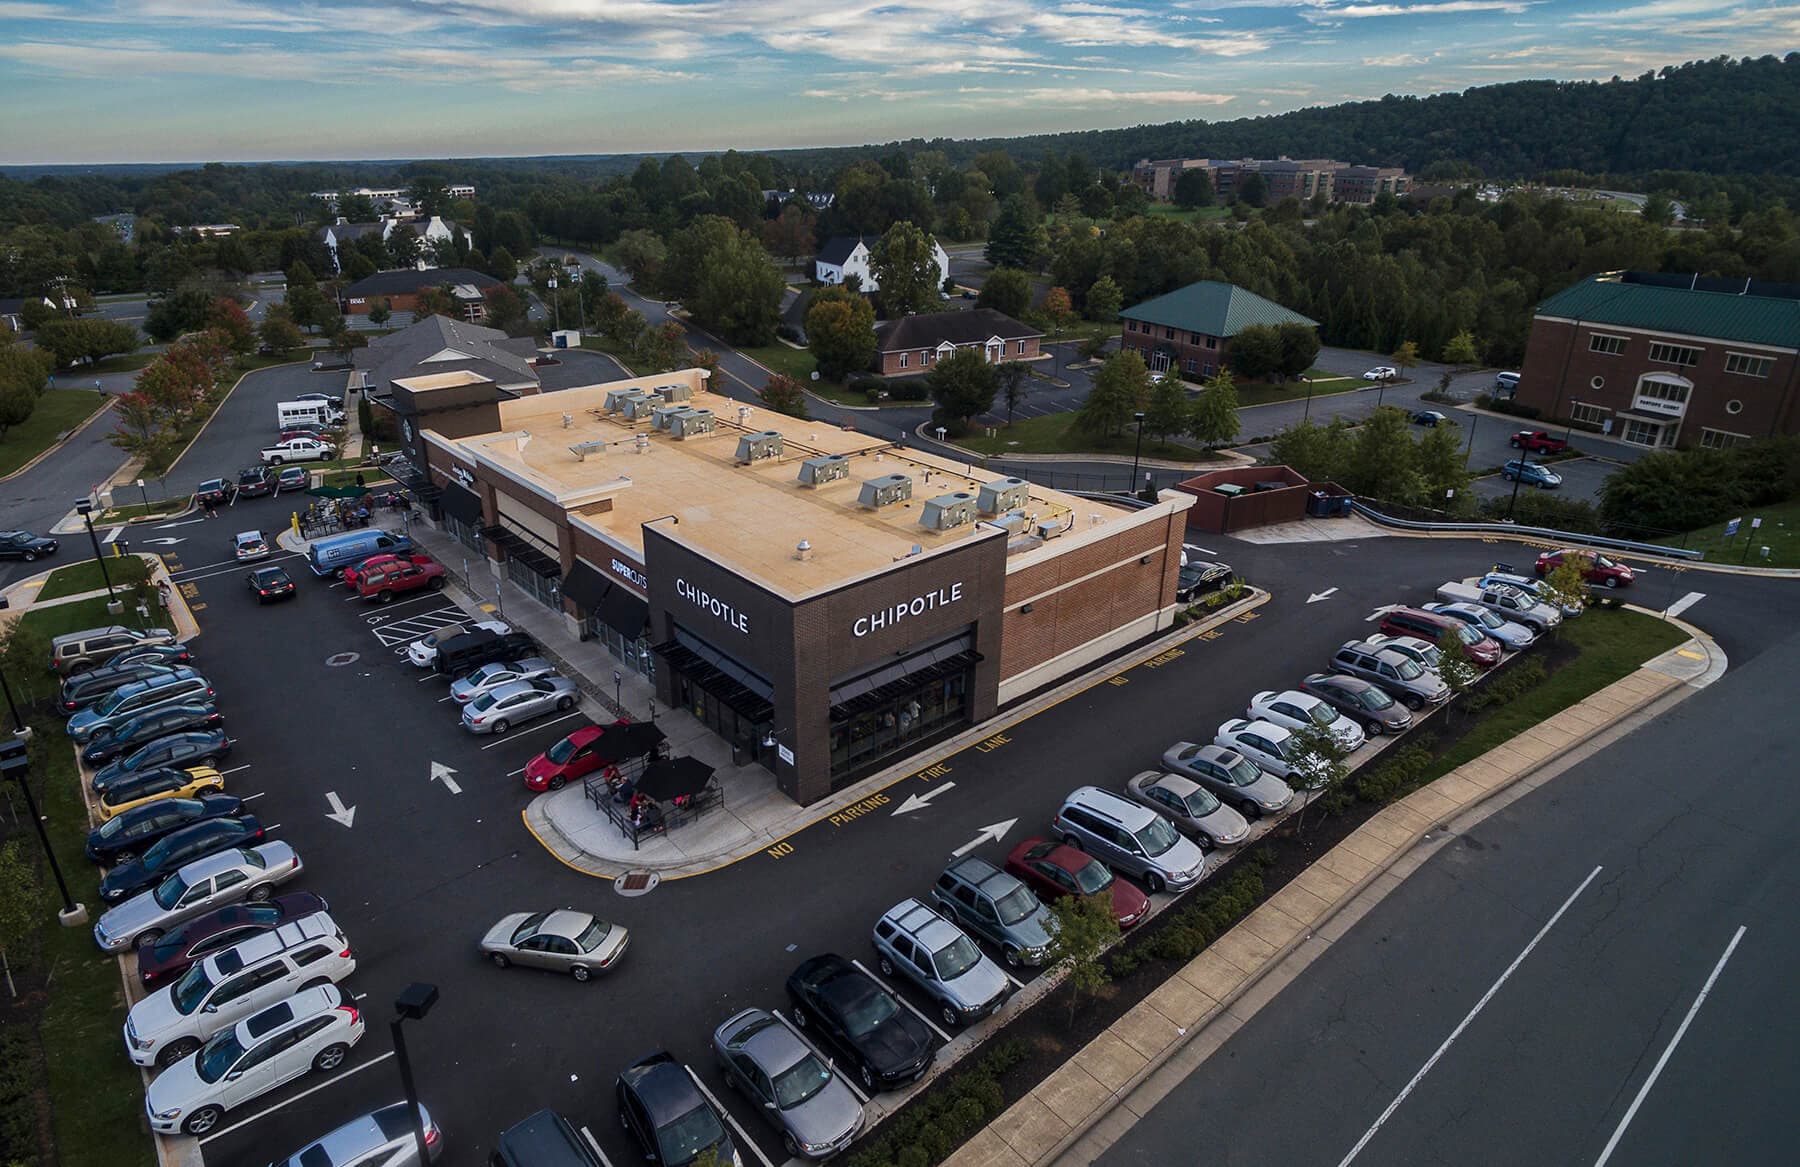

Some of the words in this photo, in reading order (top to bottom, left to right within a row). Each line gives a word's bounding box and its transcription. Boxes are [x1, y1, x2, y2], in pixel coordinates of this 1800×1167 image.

[611, 558, 648, 589] SUPERCUTS
[676, 578, 749, 634] CHIPOTLE
[853, 582, 962, 637] CHIPOTLE
[1108, 675, 1129, 687] NO
[1143, 649, 1185, 668] PARKING
[767, 841, 795, 860] NO
[829, 793, 891, 828] PARKING
[918, 763, 953, 783] FIRE
[975, 733, 1013, 753] LANE
